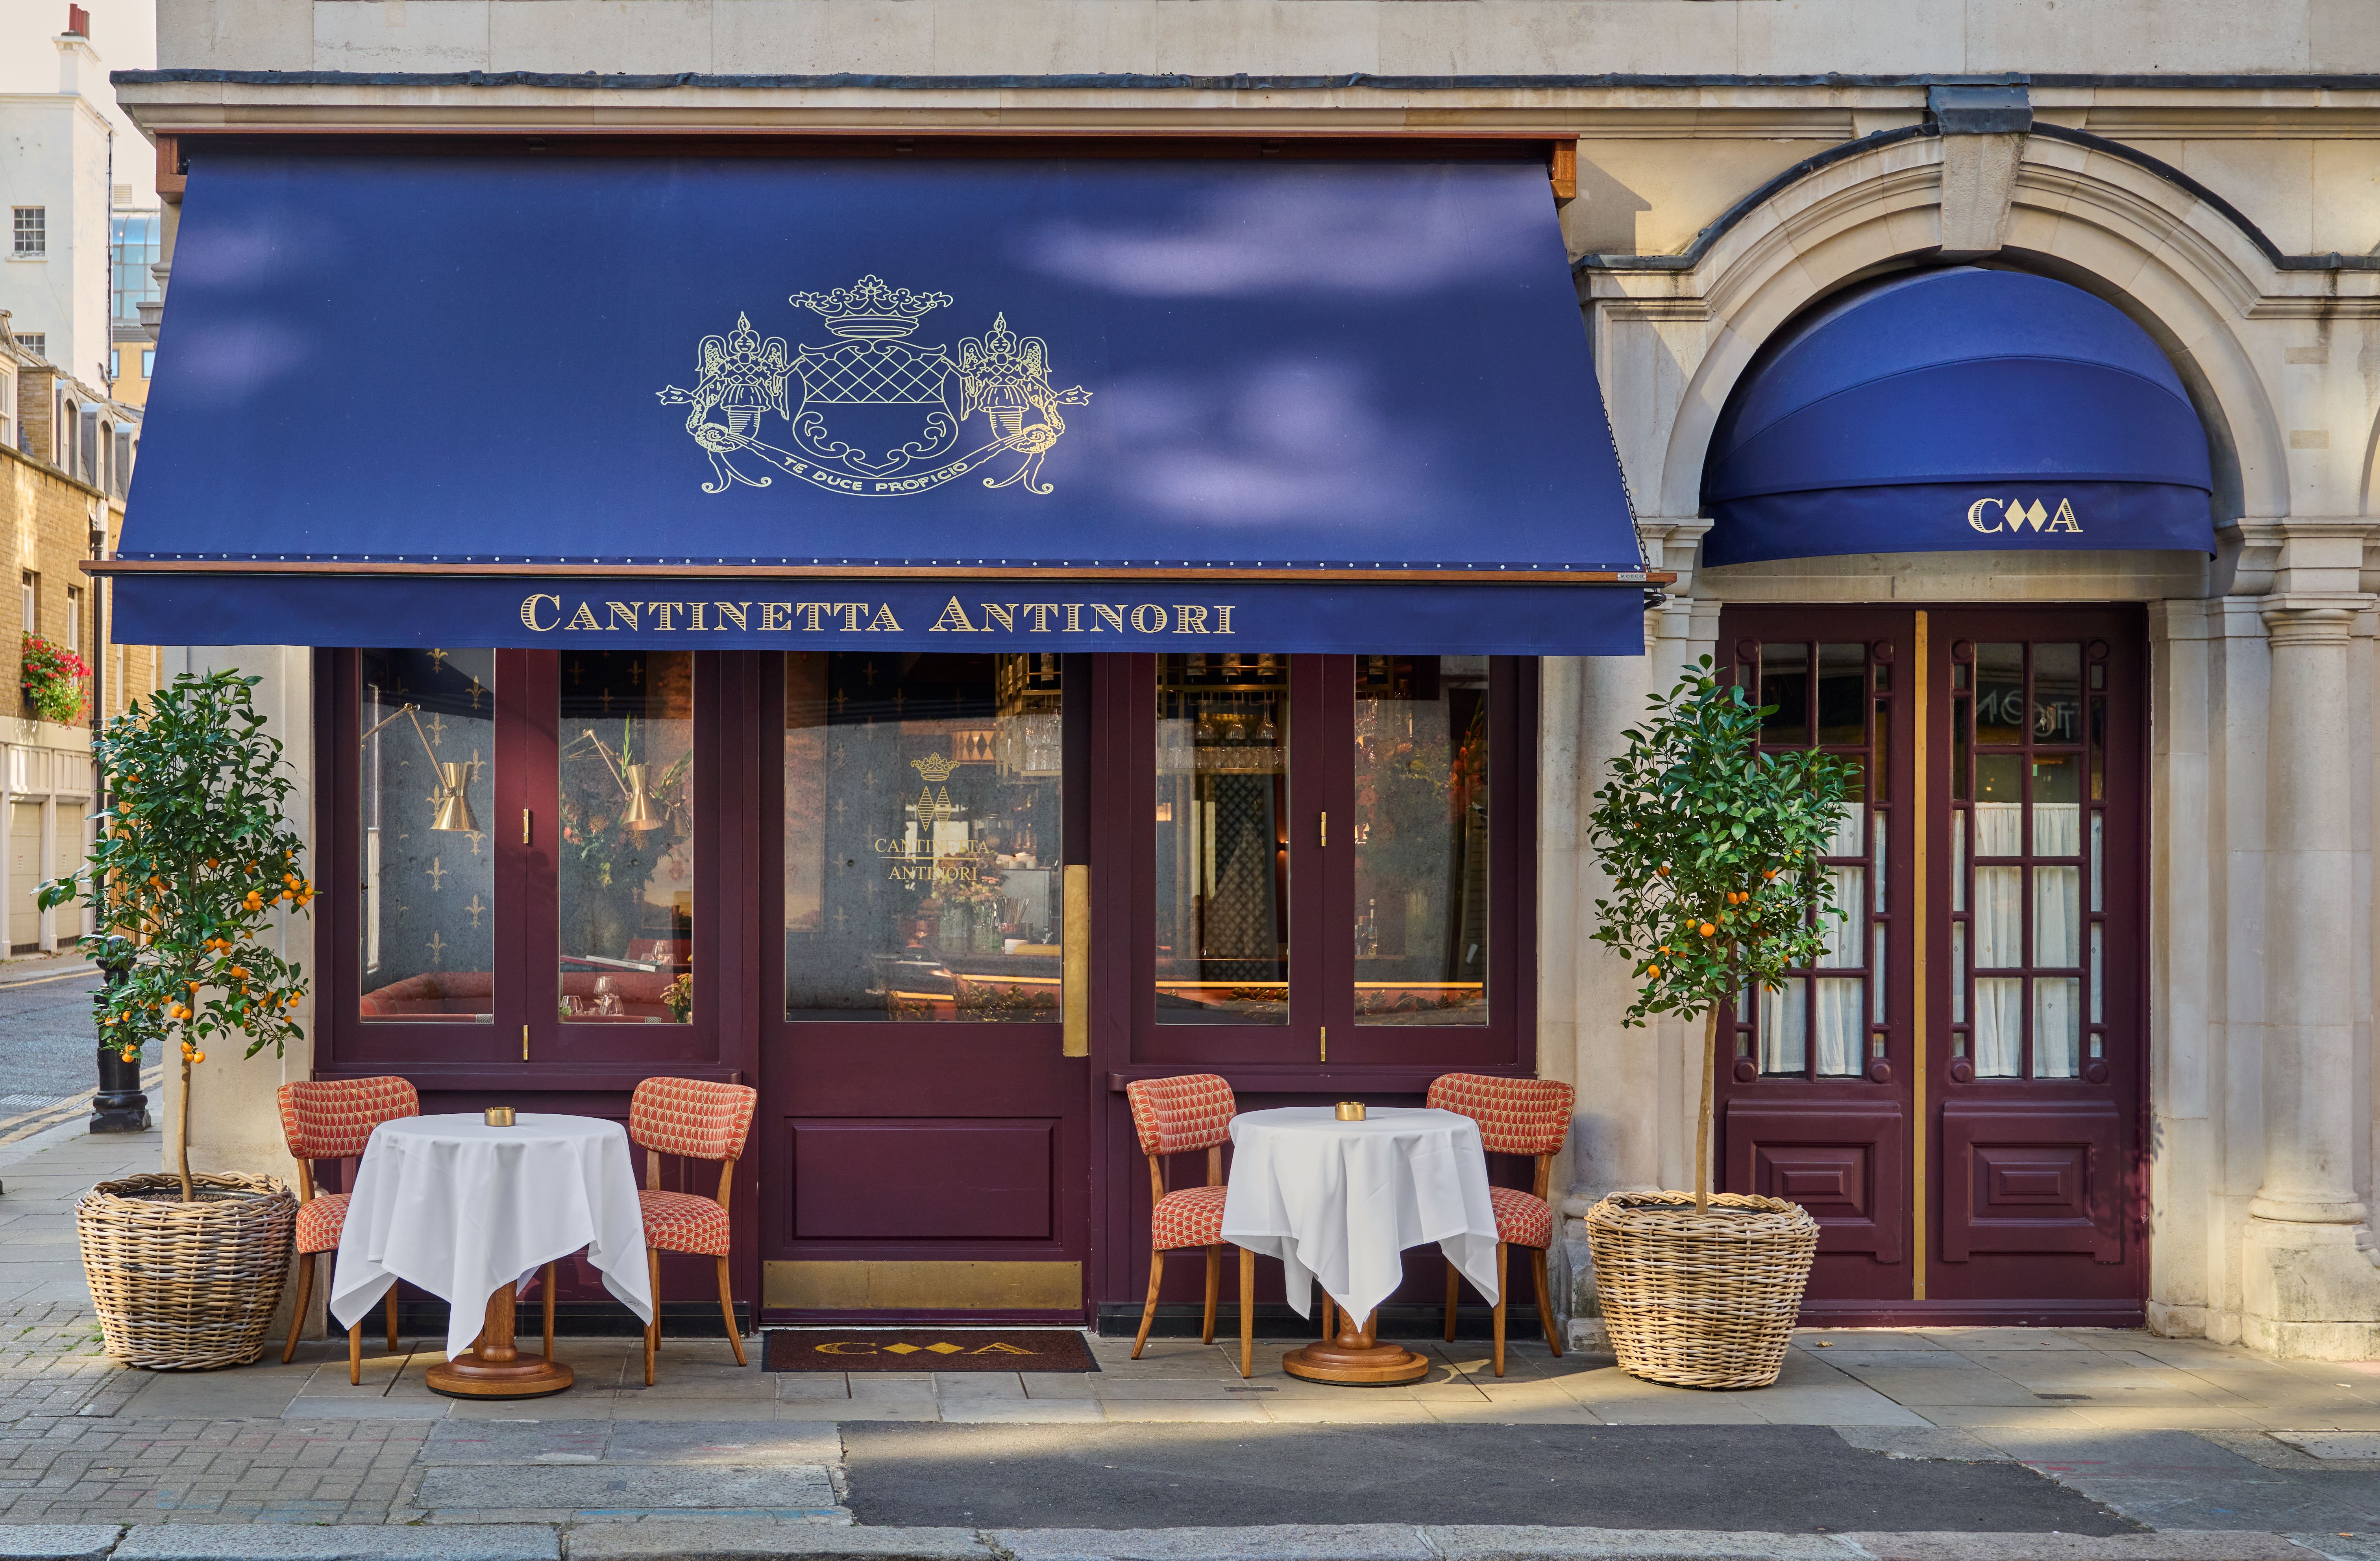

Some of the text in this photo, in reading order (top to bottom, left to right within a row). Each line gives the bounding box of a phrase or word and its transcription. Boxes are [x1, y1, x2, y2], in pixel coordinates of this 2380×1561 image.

[784, 457, 968, 491] TE DUCE PROFICIO
[520, 593, 1236, 634] CANTINETTA ANTINORI
[875, 838, 989, 854] CANTINETTA
[888, 866, 978, 881] ANTINORI
